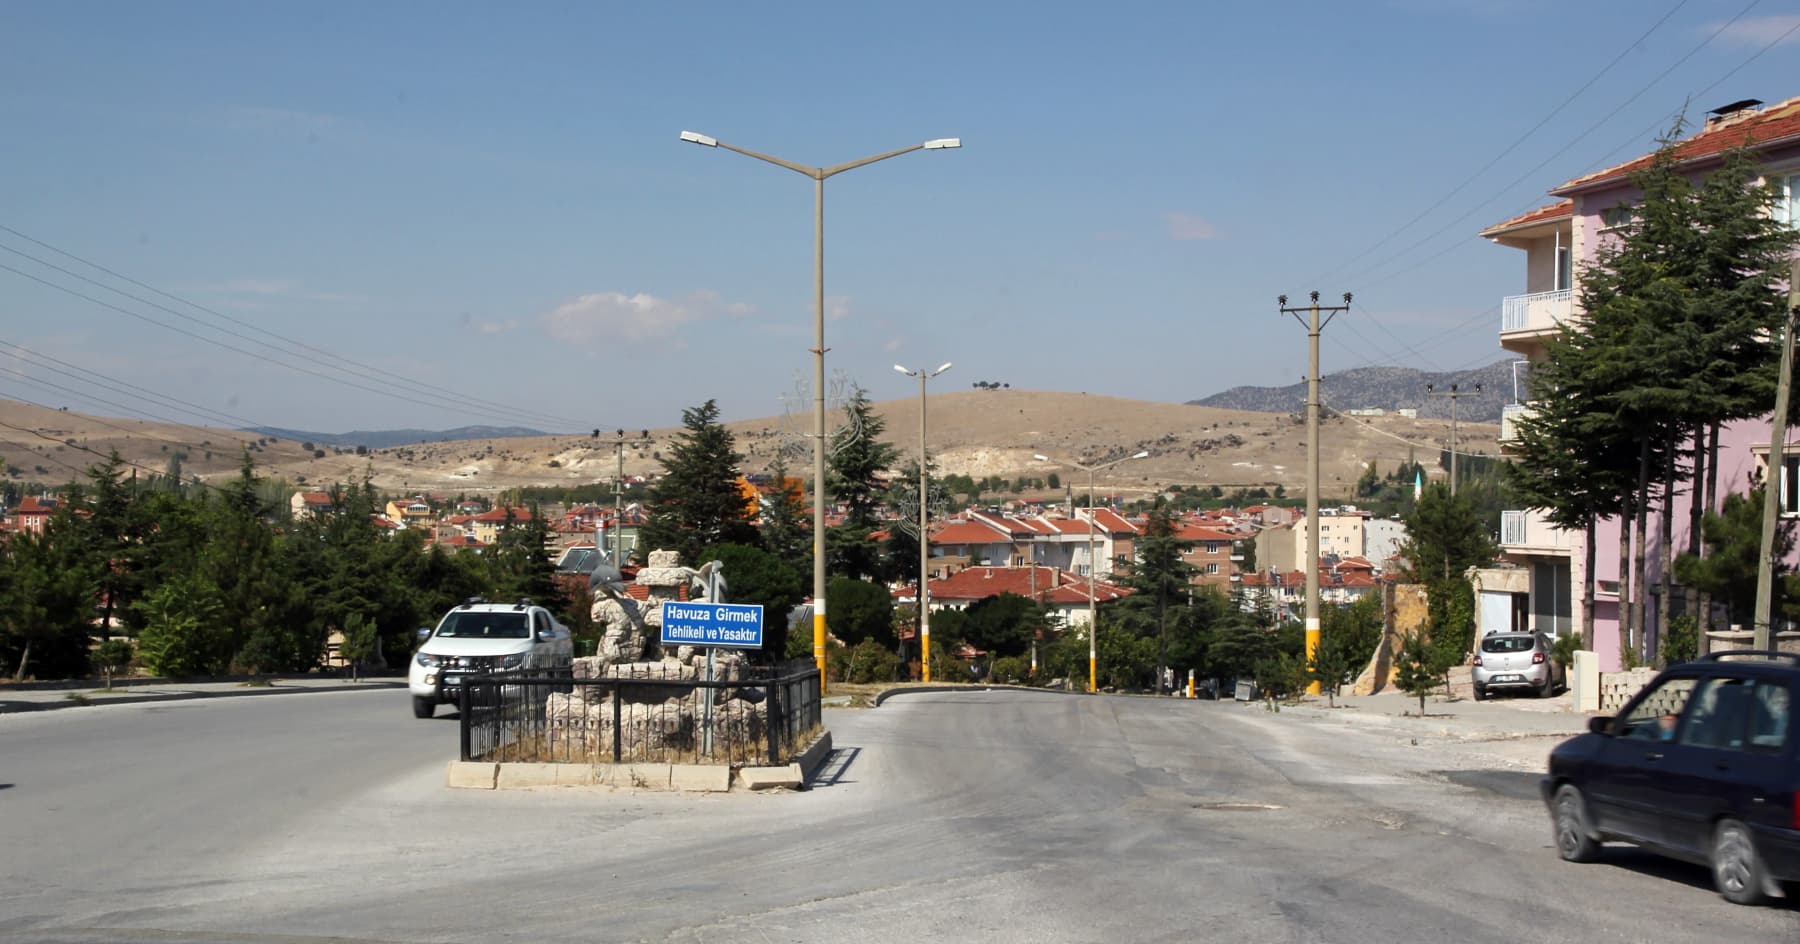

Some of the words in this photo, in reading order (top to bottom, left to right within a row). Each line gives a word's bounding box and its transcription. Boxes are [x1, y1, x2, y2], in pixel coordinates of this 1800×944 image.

[667, 606, 710, 620] Havuza
[716, 608, 757, 622] Girmek
[667, 625, 705, 639] Tehlikeli
[707, 628, 717, 639] ve
[718, 627, 757, 641] Yasaktır
